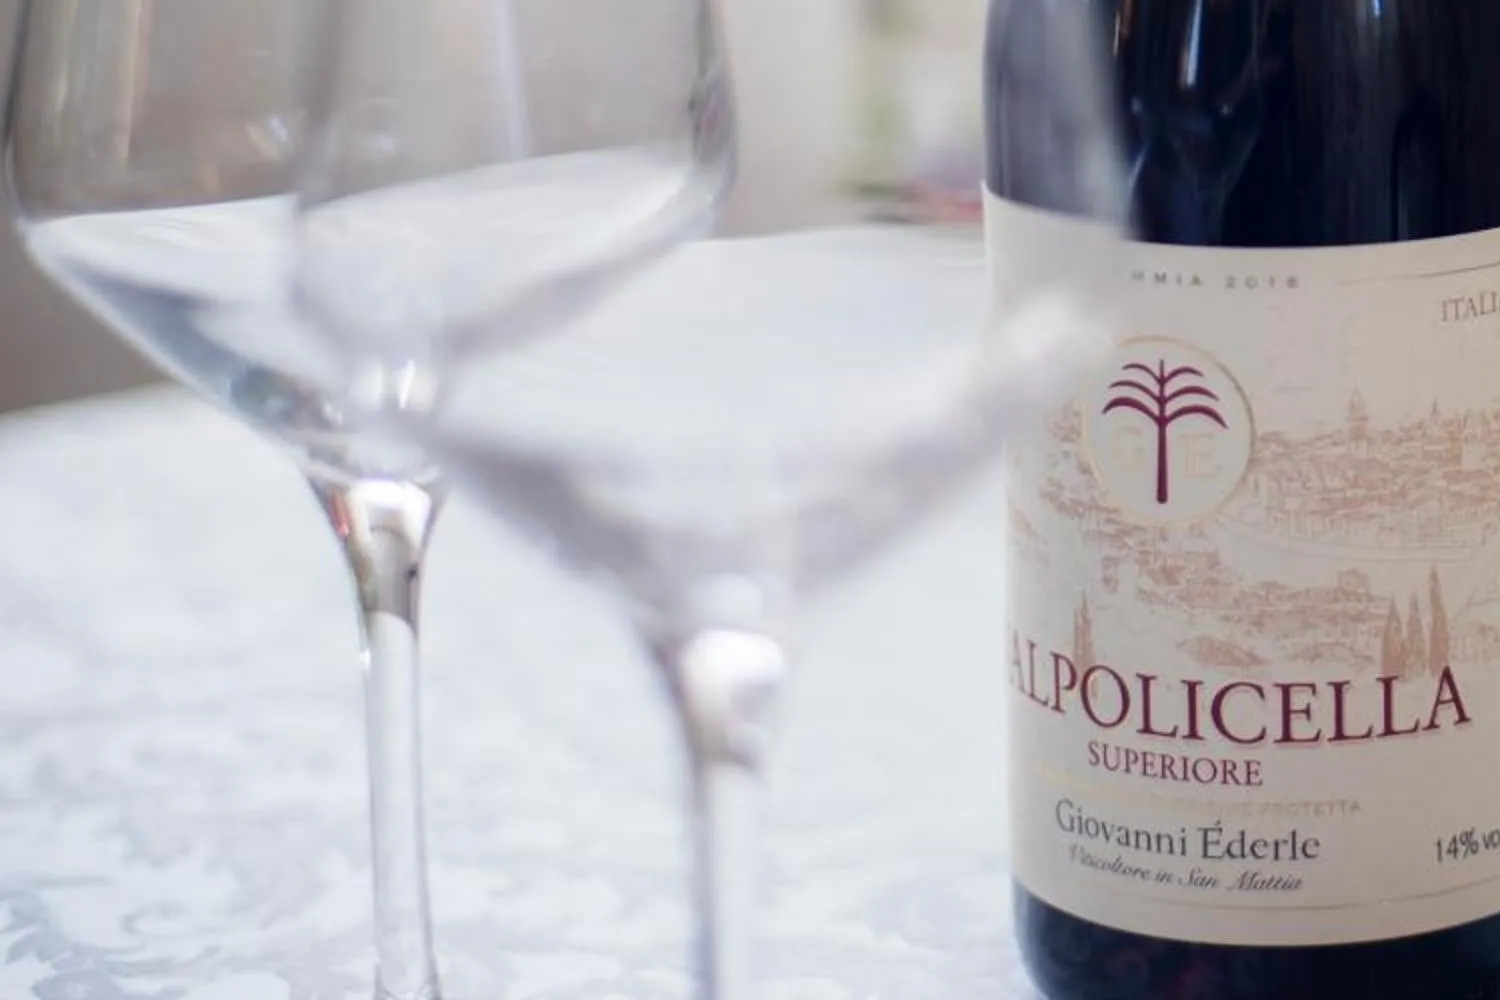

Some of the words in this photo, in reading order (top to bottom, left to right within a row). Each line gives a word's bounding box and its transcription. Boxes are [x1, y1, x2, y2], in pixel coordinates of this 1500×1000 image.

[1011, 627, 1471, 744] ALPOLICELLA
[1087, 740, 1264, 787] SUPERIORE
[1055, 798, 1187, 857] Giovanni
[1198, 819, 1320, 860] Éderle
[1434, 826, 1479, 862] 14%
[1224, 870, 1303, 891] Mattia
